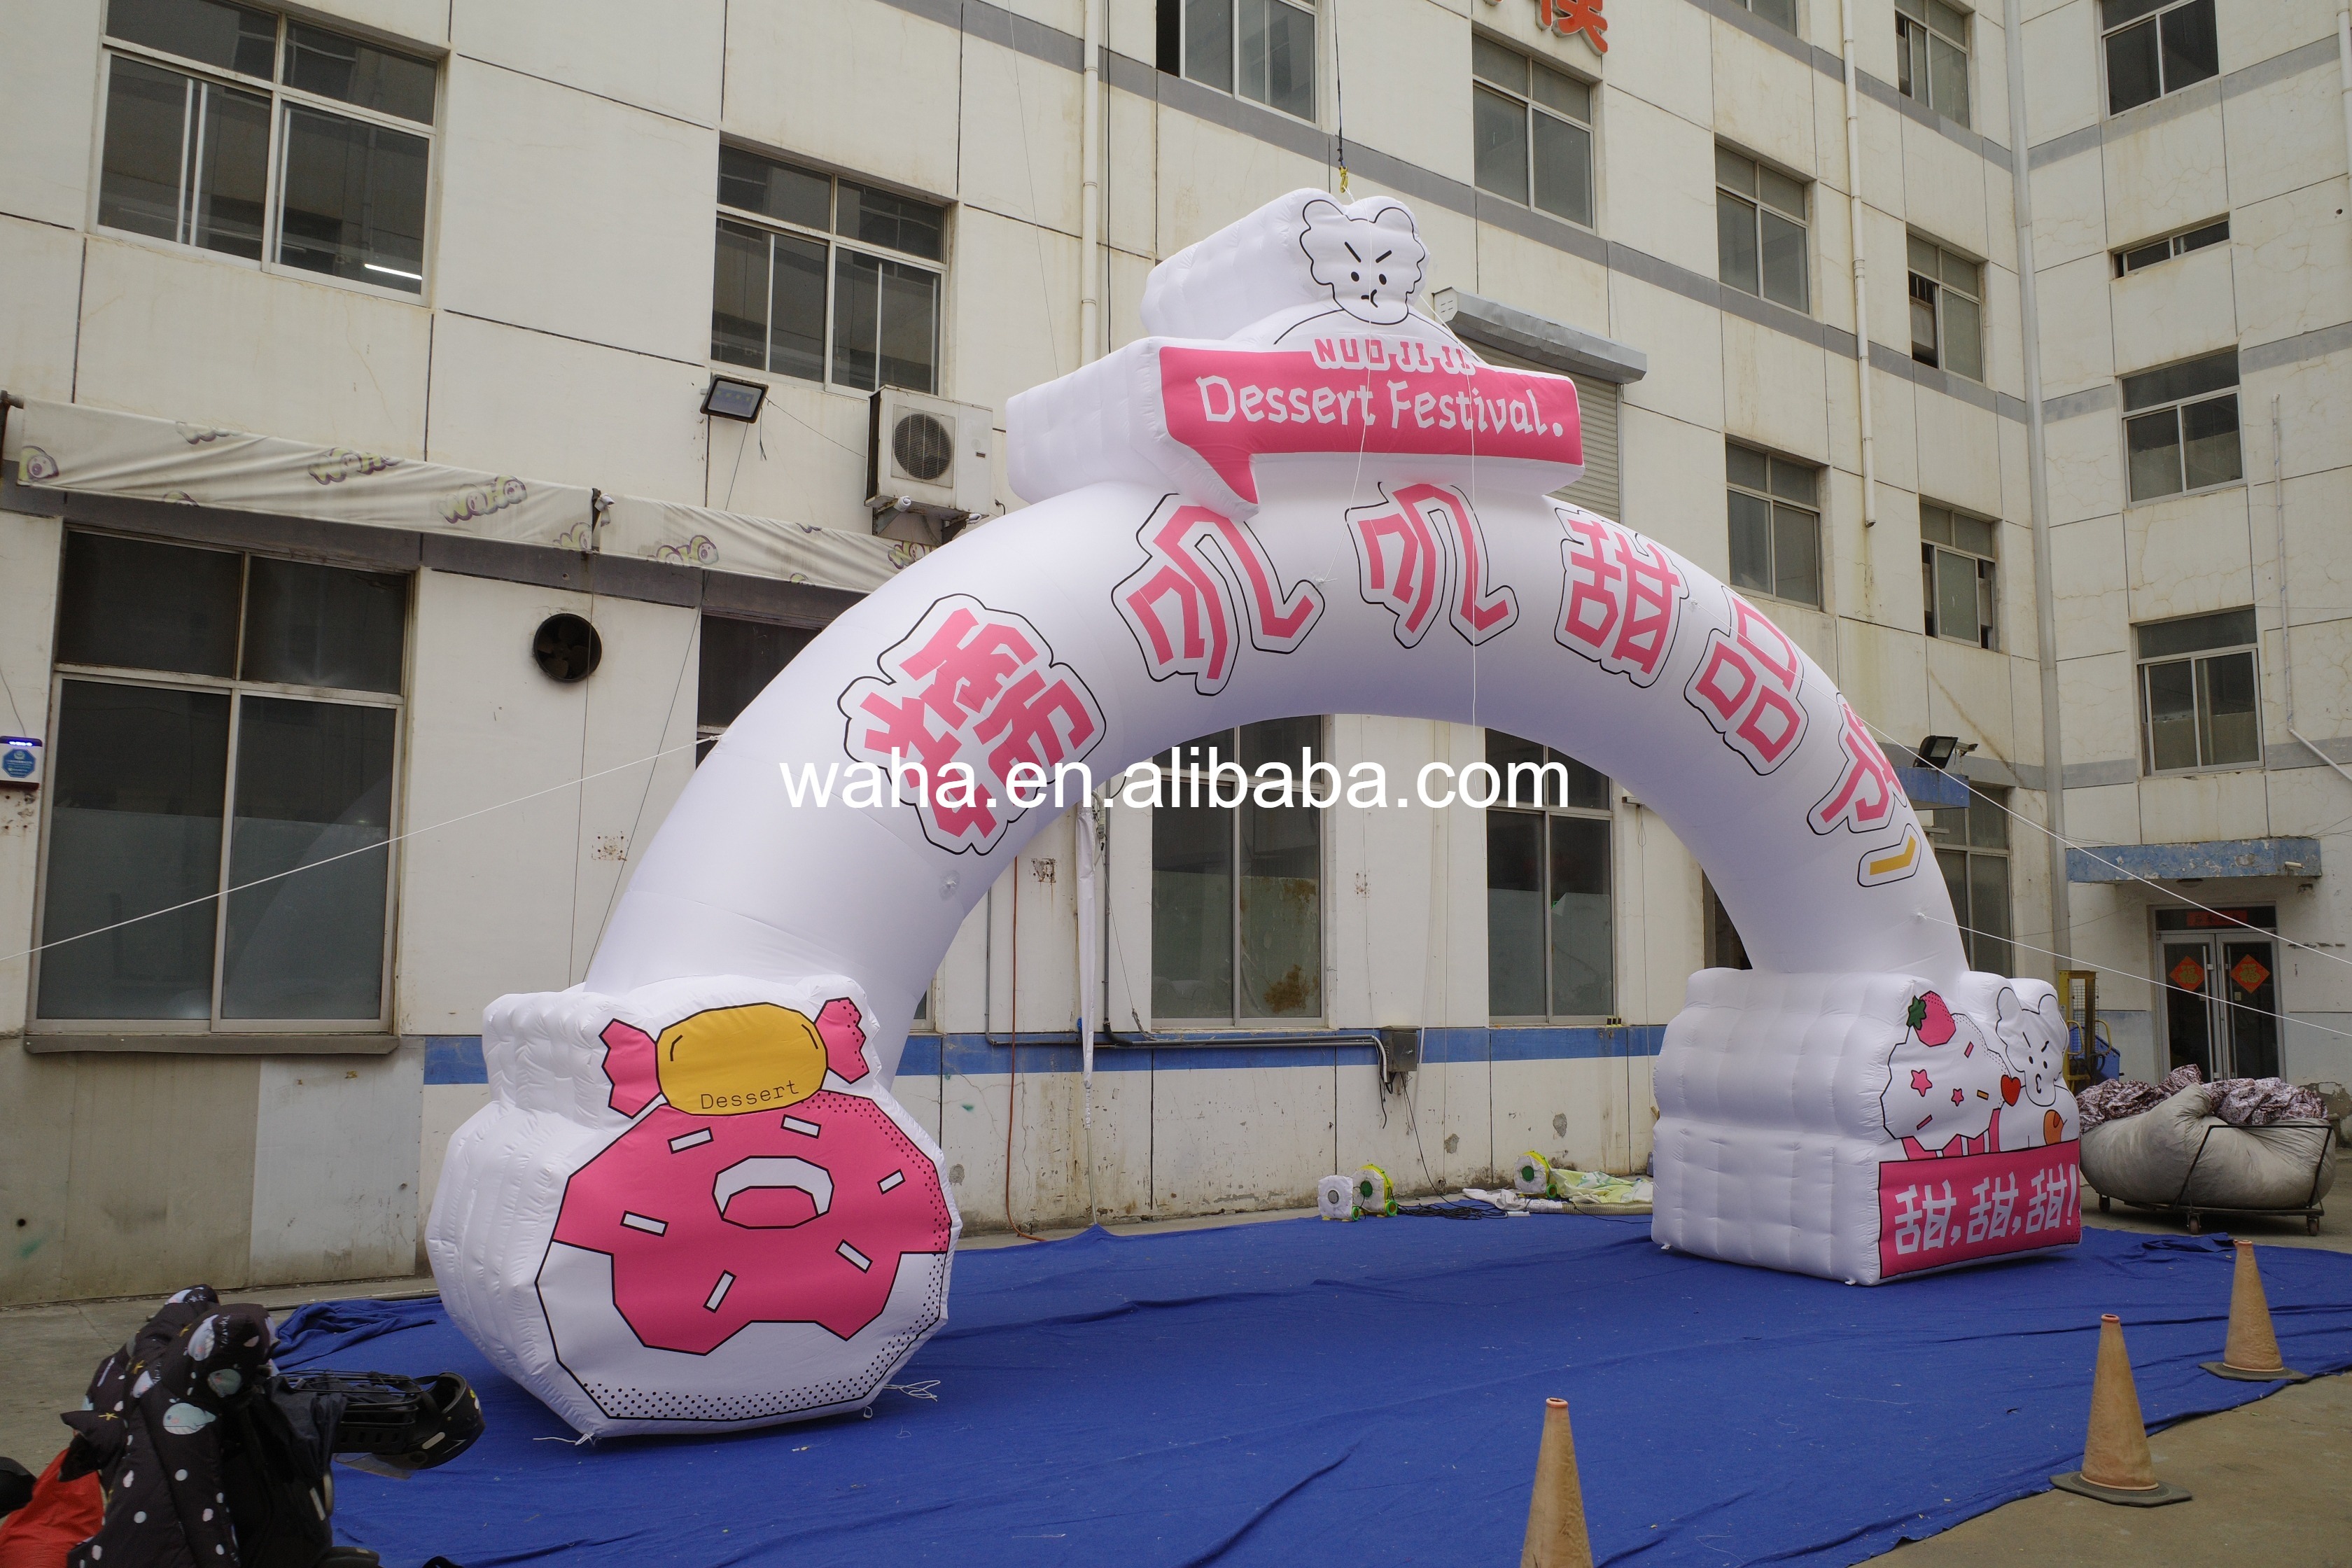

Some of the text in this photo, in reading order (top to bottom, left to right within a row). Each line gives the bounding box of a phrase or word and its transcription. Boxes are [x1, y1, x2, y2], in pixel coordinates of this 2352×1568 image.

[1196, 375, 1564, 438] Dessert Festival.
[701, 1080, 799, 1110] Dessert
